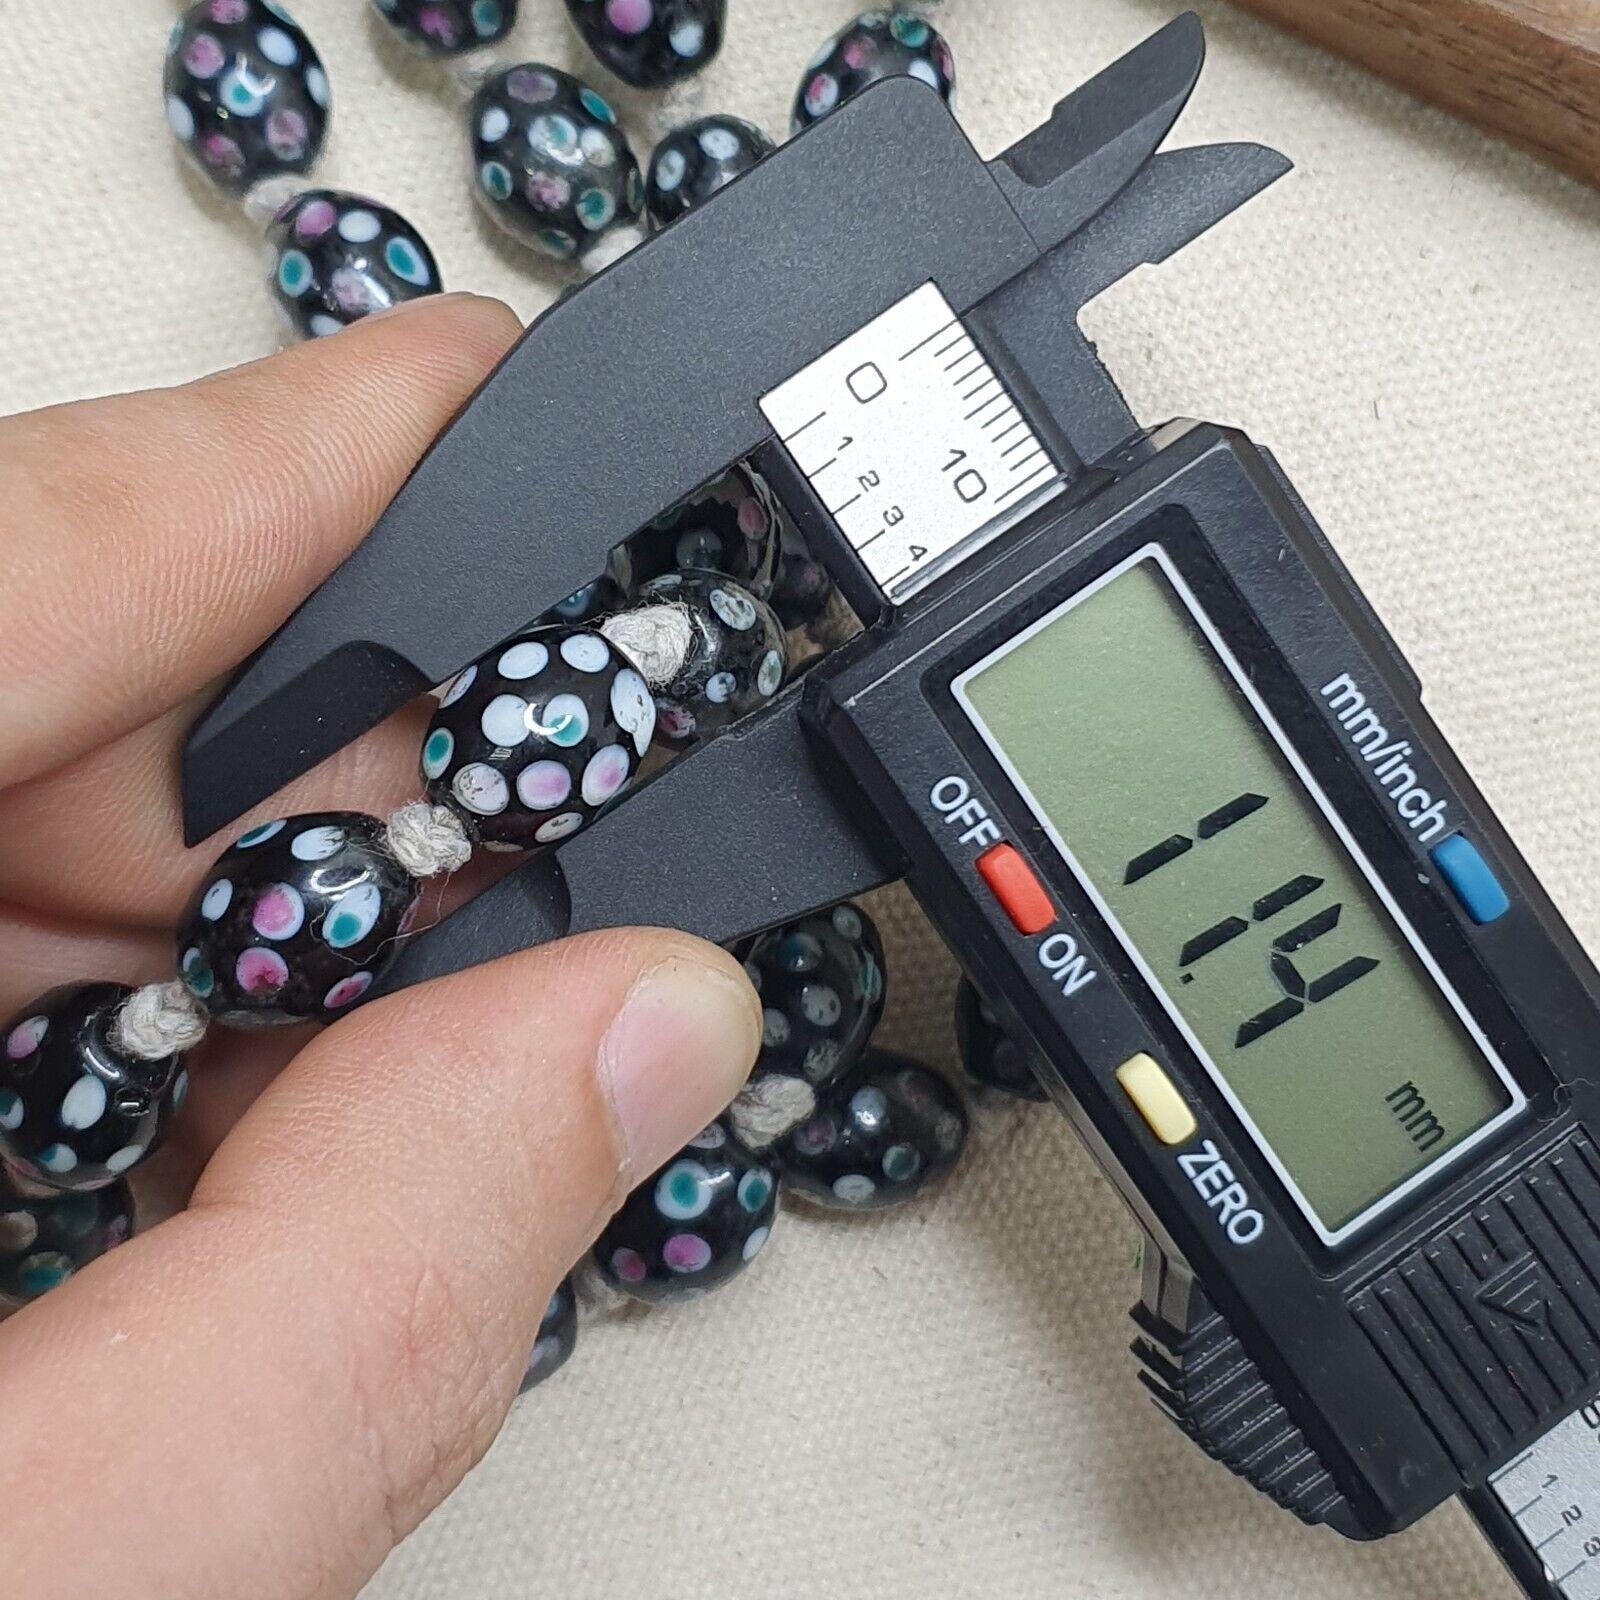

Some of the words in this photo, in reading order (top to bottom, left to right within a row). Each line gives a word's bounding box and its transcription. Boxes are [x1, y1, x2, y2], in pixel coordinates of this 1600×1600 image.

[846, 361, 888, 404] 0
[837, 436, 854, 451] 1
[858, 470, 880, 493] 2
[941, 448, 987, 503] 10
[883, 505, 904, 527] 3
[908, 544, 928, 562] 4
[1319, 672, 1448, 842] mm/inch
[929, 775, 1001, 847] OFF
[1038, 932, 1098, 997] ON
[1385, 1079, 1447, 1153] mm
[1176, 1138, 1265, 1245] ZERO
[1541, 1474, 1559, 1489] 1
[1560, 1504, 1583, 1527] 2
